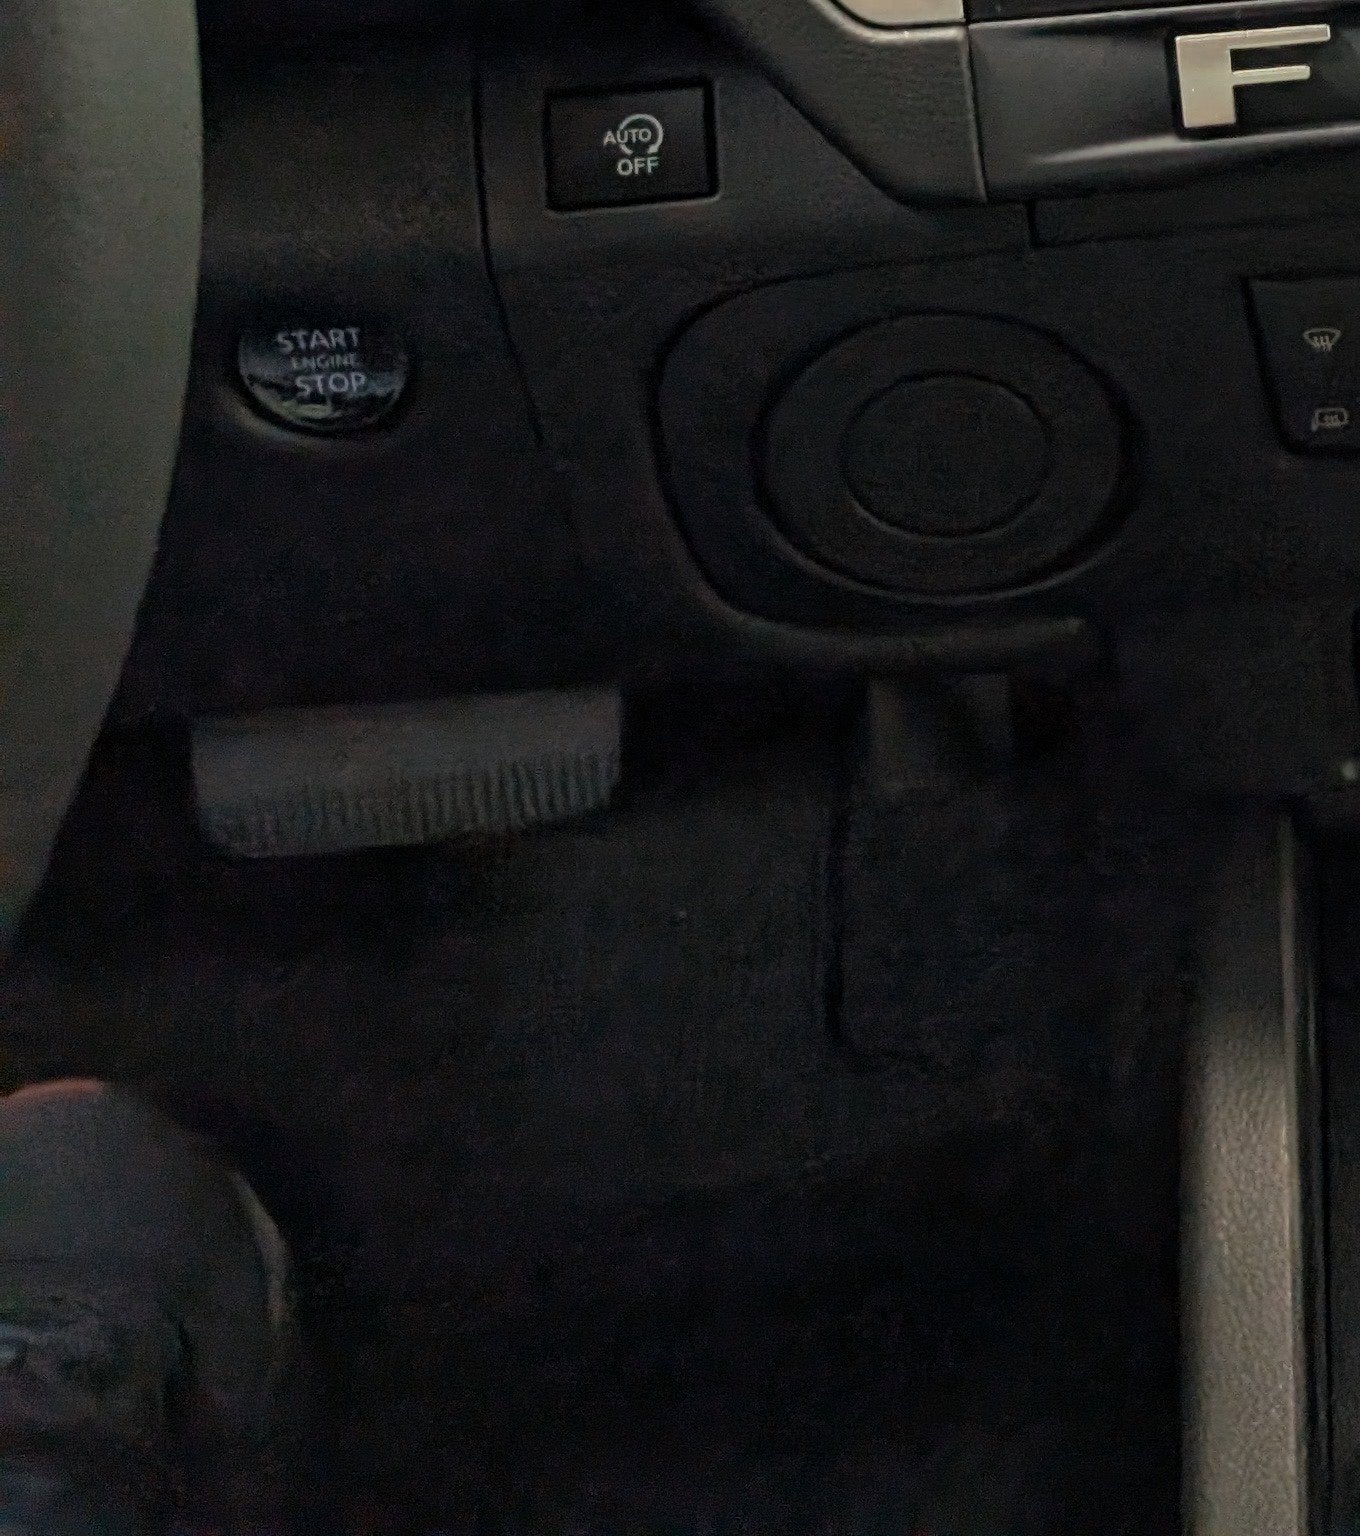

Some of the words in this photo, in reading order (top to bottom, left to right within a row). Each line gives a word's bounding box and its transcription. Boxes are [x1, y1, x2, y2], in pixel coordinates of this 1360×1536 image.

[603, 126, 652, 146] AUTO
[616, 156, 659, 177] OFF
[276, 325, 361, 354] START
[295, 371, 367, 399] STOP
